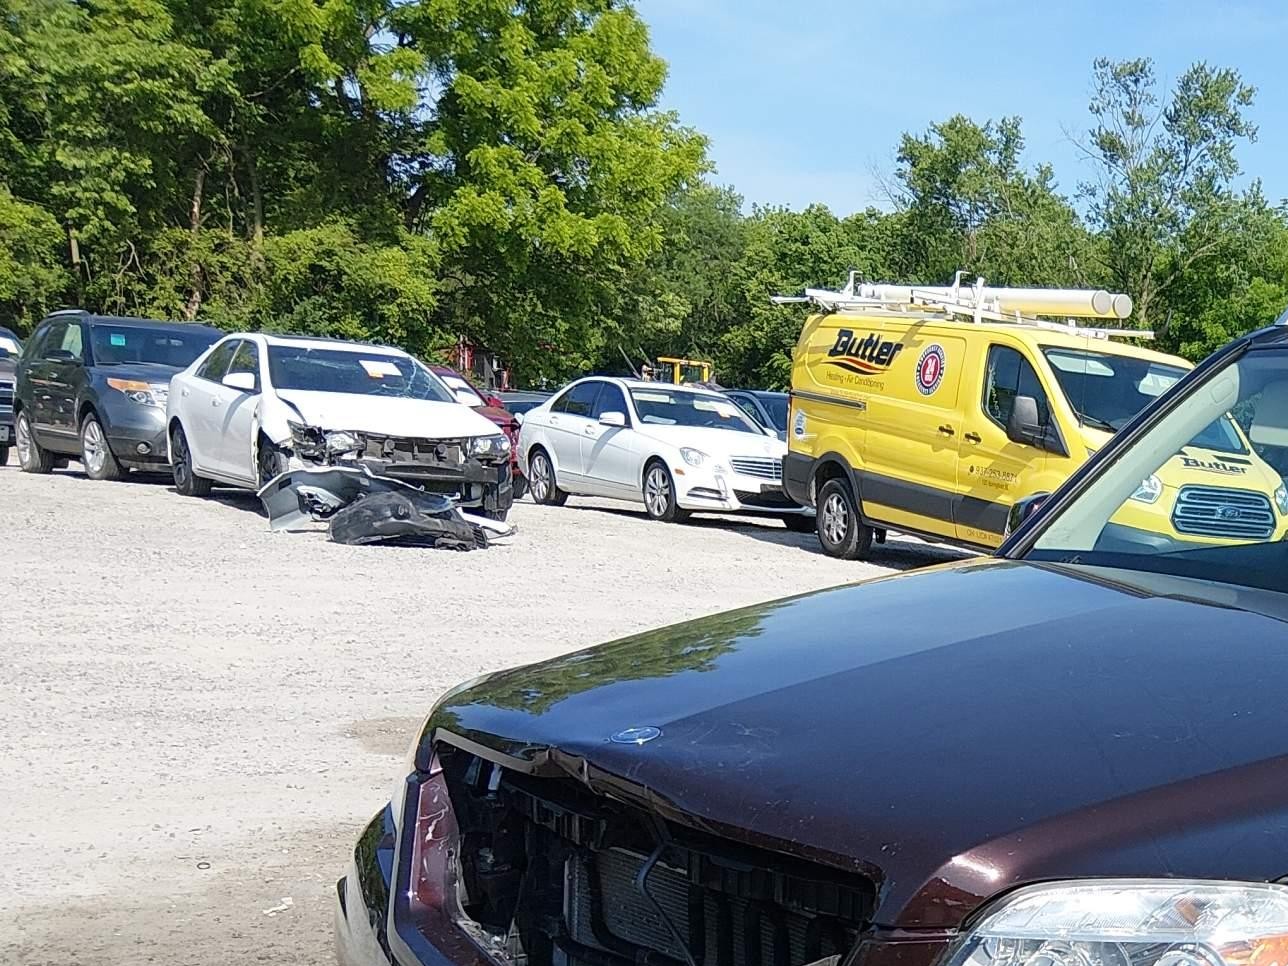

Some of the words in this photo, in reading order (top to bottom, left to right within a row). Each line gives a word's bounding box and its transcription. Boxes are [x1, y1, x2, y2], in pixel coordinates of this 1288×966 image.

[828, 329, 904, 366] Butler
[854, 375, 885, 391] Conditioning
[1182, 457, 1247, 473] Butler
